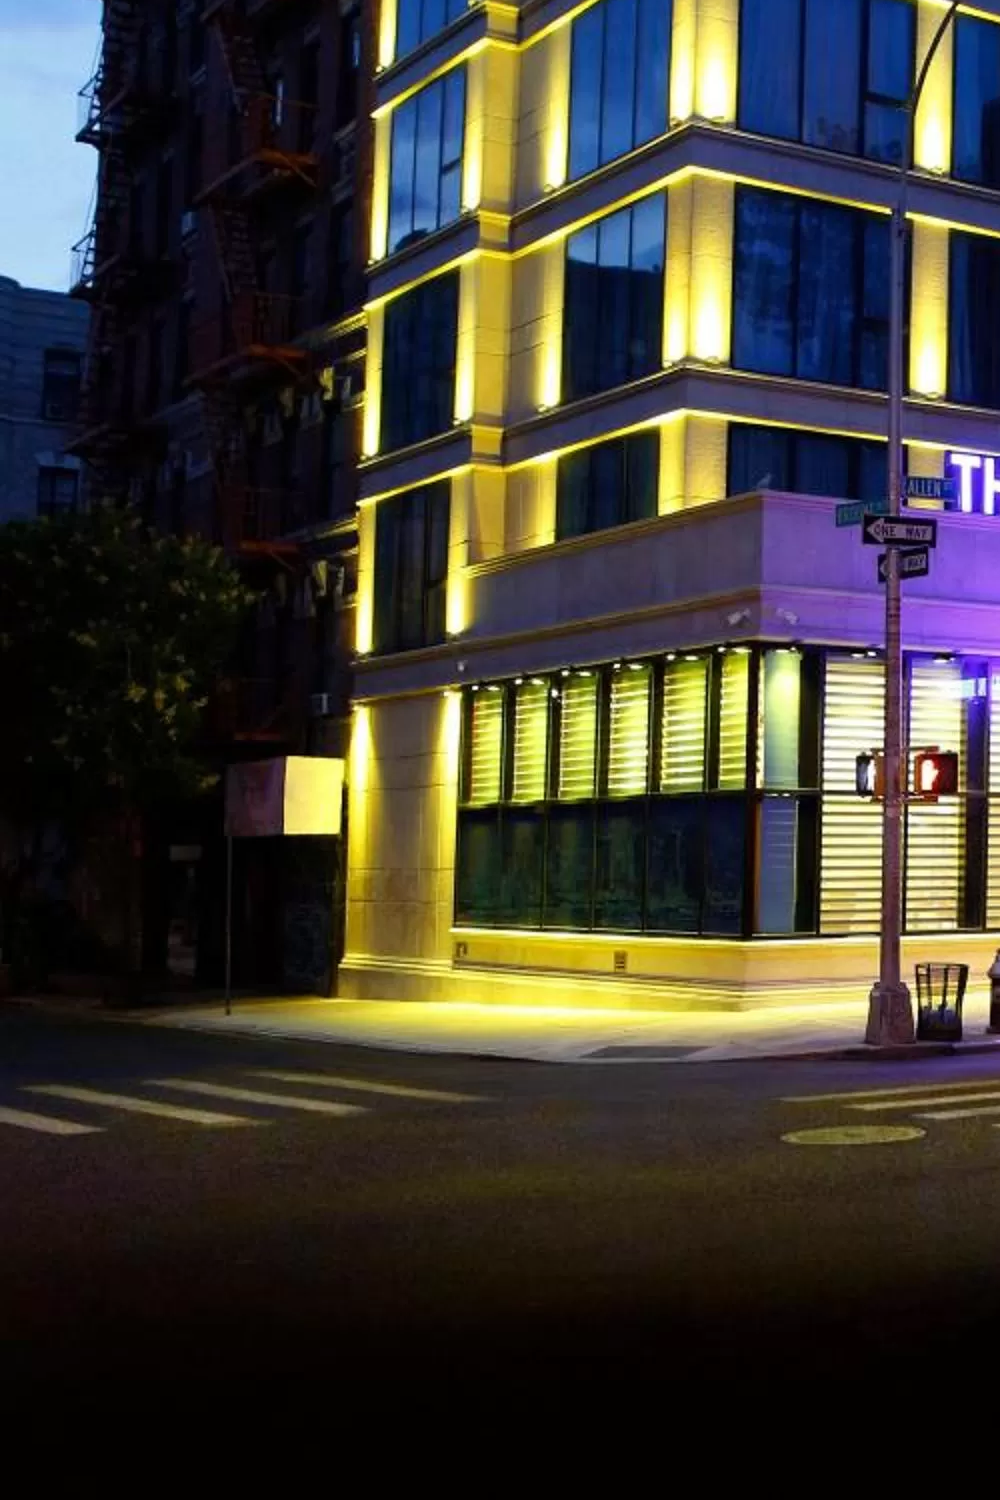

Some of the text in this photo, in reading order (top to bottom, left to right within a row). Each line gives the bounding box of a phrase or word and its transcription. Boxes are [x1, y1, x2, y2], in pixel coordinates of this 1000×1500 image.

[907, 478, 941, 497] ALLEN
[873, 524, 929, 540] ONE WAY
